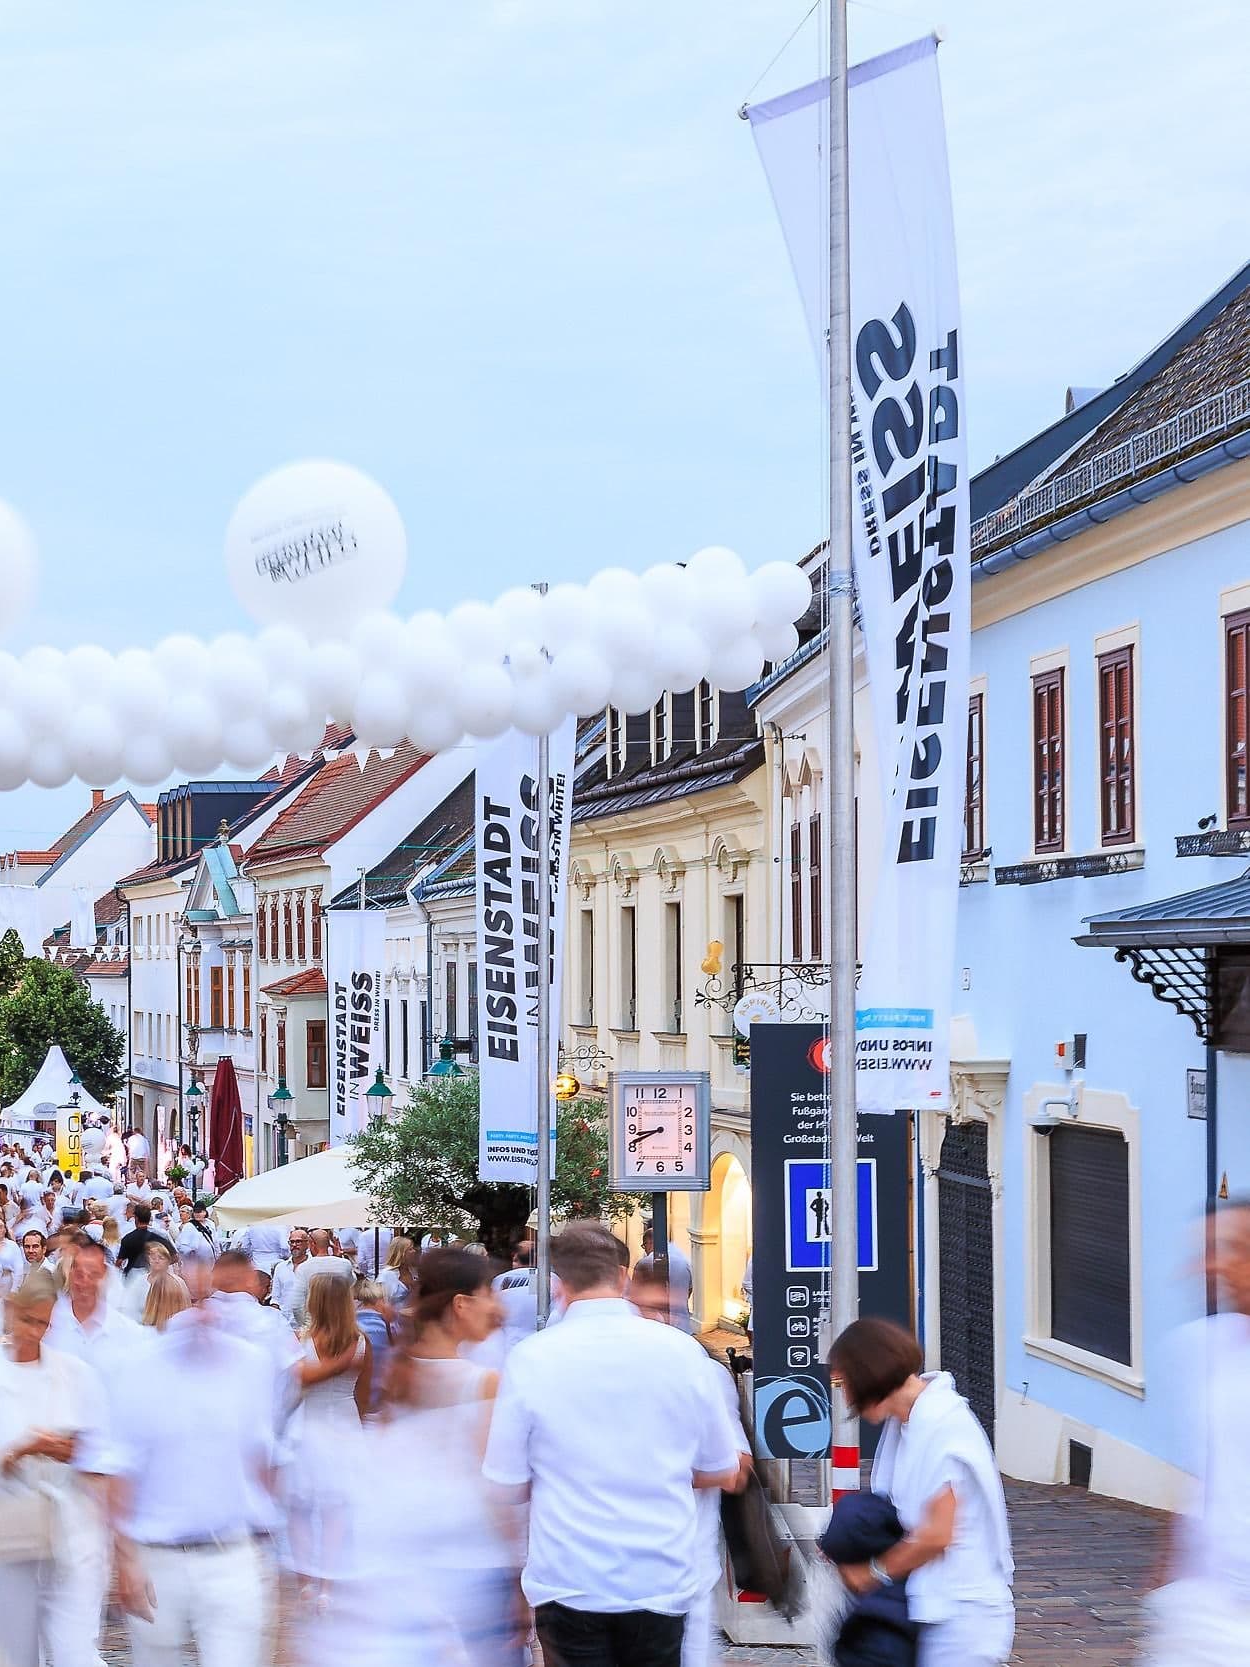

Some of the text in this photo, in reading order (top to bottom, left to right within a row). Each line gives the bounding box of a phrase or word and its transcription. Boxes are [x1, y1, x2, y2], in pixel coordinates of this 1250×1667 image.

[484, 795, 519, 1062] EISENSTADT
[350, 971, 373, 1100] IN WEISS
[334, 982, 348, 1116] EISENSTADT
[635, 1087, 644, 1099] 11
[653, 1087, 667, 1099] 12
[678, 1087, 683, 1099] 1
[790, 1092, 806, 1102] Sie
[626, 1106, 637, 1118] 10
[683, 1106, 693, 1118] 2
[628, 1123, 637, 1135] 9
[684, 1124, 693, 1136] 3
[797, 1120, 815, 1130] der
[628, 1141, 637, 1153] 8
[683, 1142, 693, 1153] 4
[636, 1161, 645, 1172] 7
[656, 1161, 665, 1173] 6
[674, 1161, 684, 1172] 5
